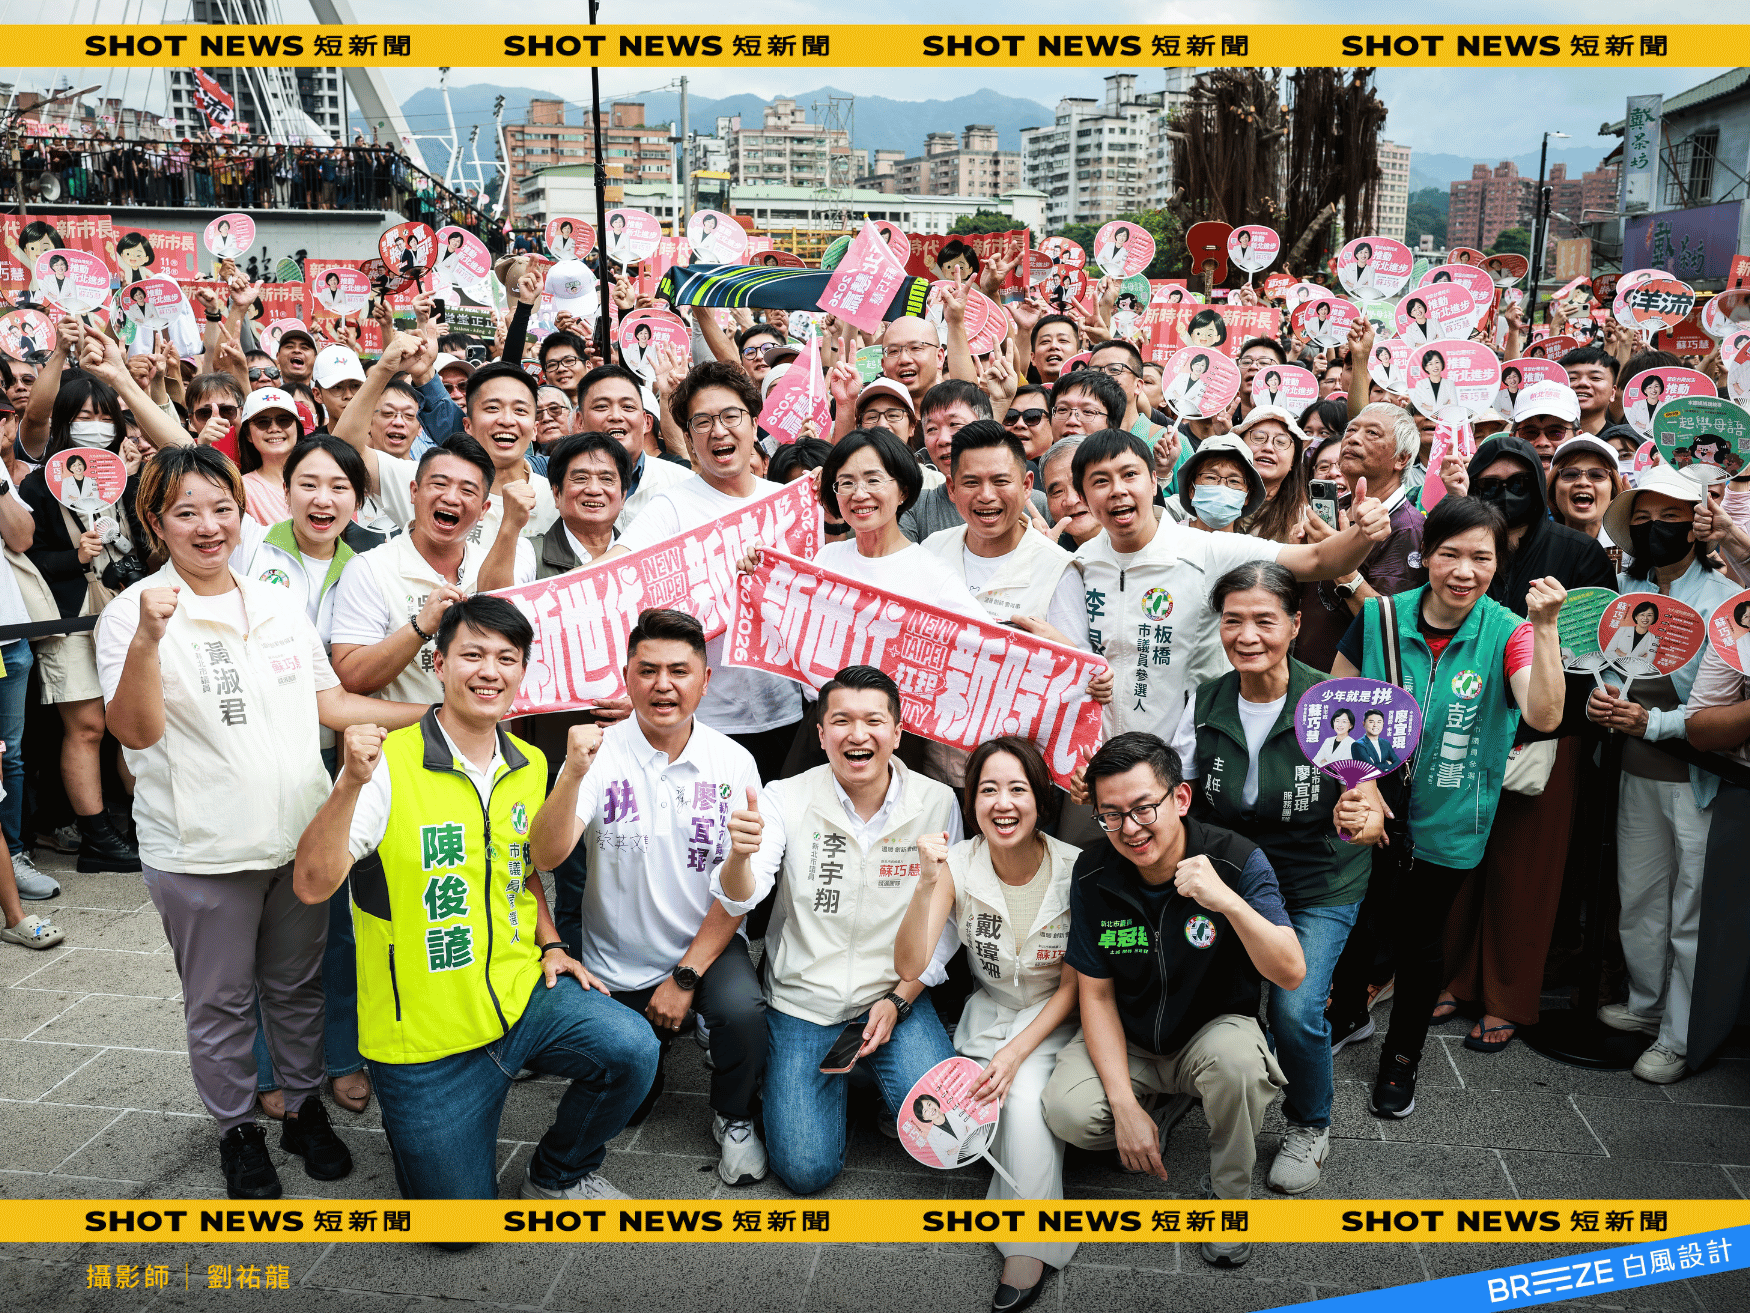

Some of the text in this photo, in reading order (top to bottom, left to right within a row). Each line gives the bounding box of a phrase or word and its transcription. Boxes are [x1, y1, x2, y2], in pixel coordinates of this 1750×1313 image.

[56, 219, 113, 240] 新市長
[148, 233, 195, 252] 新市長
[1369, 259, 1409, 274] 新北進步
[1372, 249, 1393, 262] 推動
[257, 286, 305, 303] 新市長
[1427, 295, 1449, 309] 推動
[1429, 299, 1471, 320] 新北進步
[1631, 288, 1694, 317] 洋流
[1146, 307, 1193, 326] 新時代
[1223, 309, 1273, 330] 新市長
[1675, 339, 1711, 351] 蘇巧慧
[1446, 356, 1472, 370] 推動
[1446, 368, 1496, 383] 新北進步
[1523, 371, 1545, 384] 推動
[1665, 382, 1691, 395] 推動
[1666, 415, 1747, 437] 一起學母語
[797, 480, 816, 535] 2026
[640, 546, 684, 583] NEW
[646, 571, 689, 607] TAIPEI
[757, 556, 907, 696] 新世代
[906, 608, 959, 645] NEW
[1608, 600, 1629, 629] 蘇巧慧
[1712, 615, 1736, 649] 蘇巧慧
[733, 603, 754, 662] 2026
[1151, 624, 1173, 666] 板橋
[900, 632, 948, 671] TAIPEI
[1132, 622, 1152, 713] 市議員參選人
[203, 639, 248, 727] 黃淑君
[933, 619, 1106, 778] 新時代
[1305, 703, 1323, 744] 蘇巧慧
[1391, 709, 1409, 750] 廖宜琨
[1211, 756, 1225, 793] 主任
[1293, 764, 1311, 812] 廖宜琨
[1309, 765, 1321, 803] 北市議員
[813, 832, 847, 915] 李宇翔
[878, 862, 921, 878] 蘇巧慧
[419, 820, 476, 974] 陳俊諺
[974, 912, 1003, 979] 戴瑋姍
